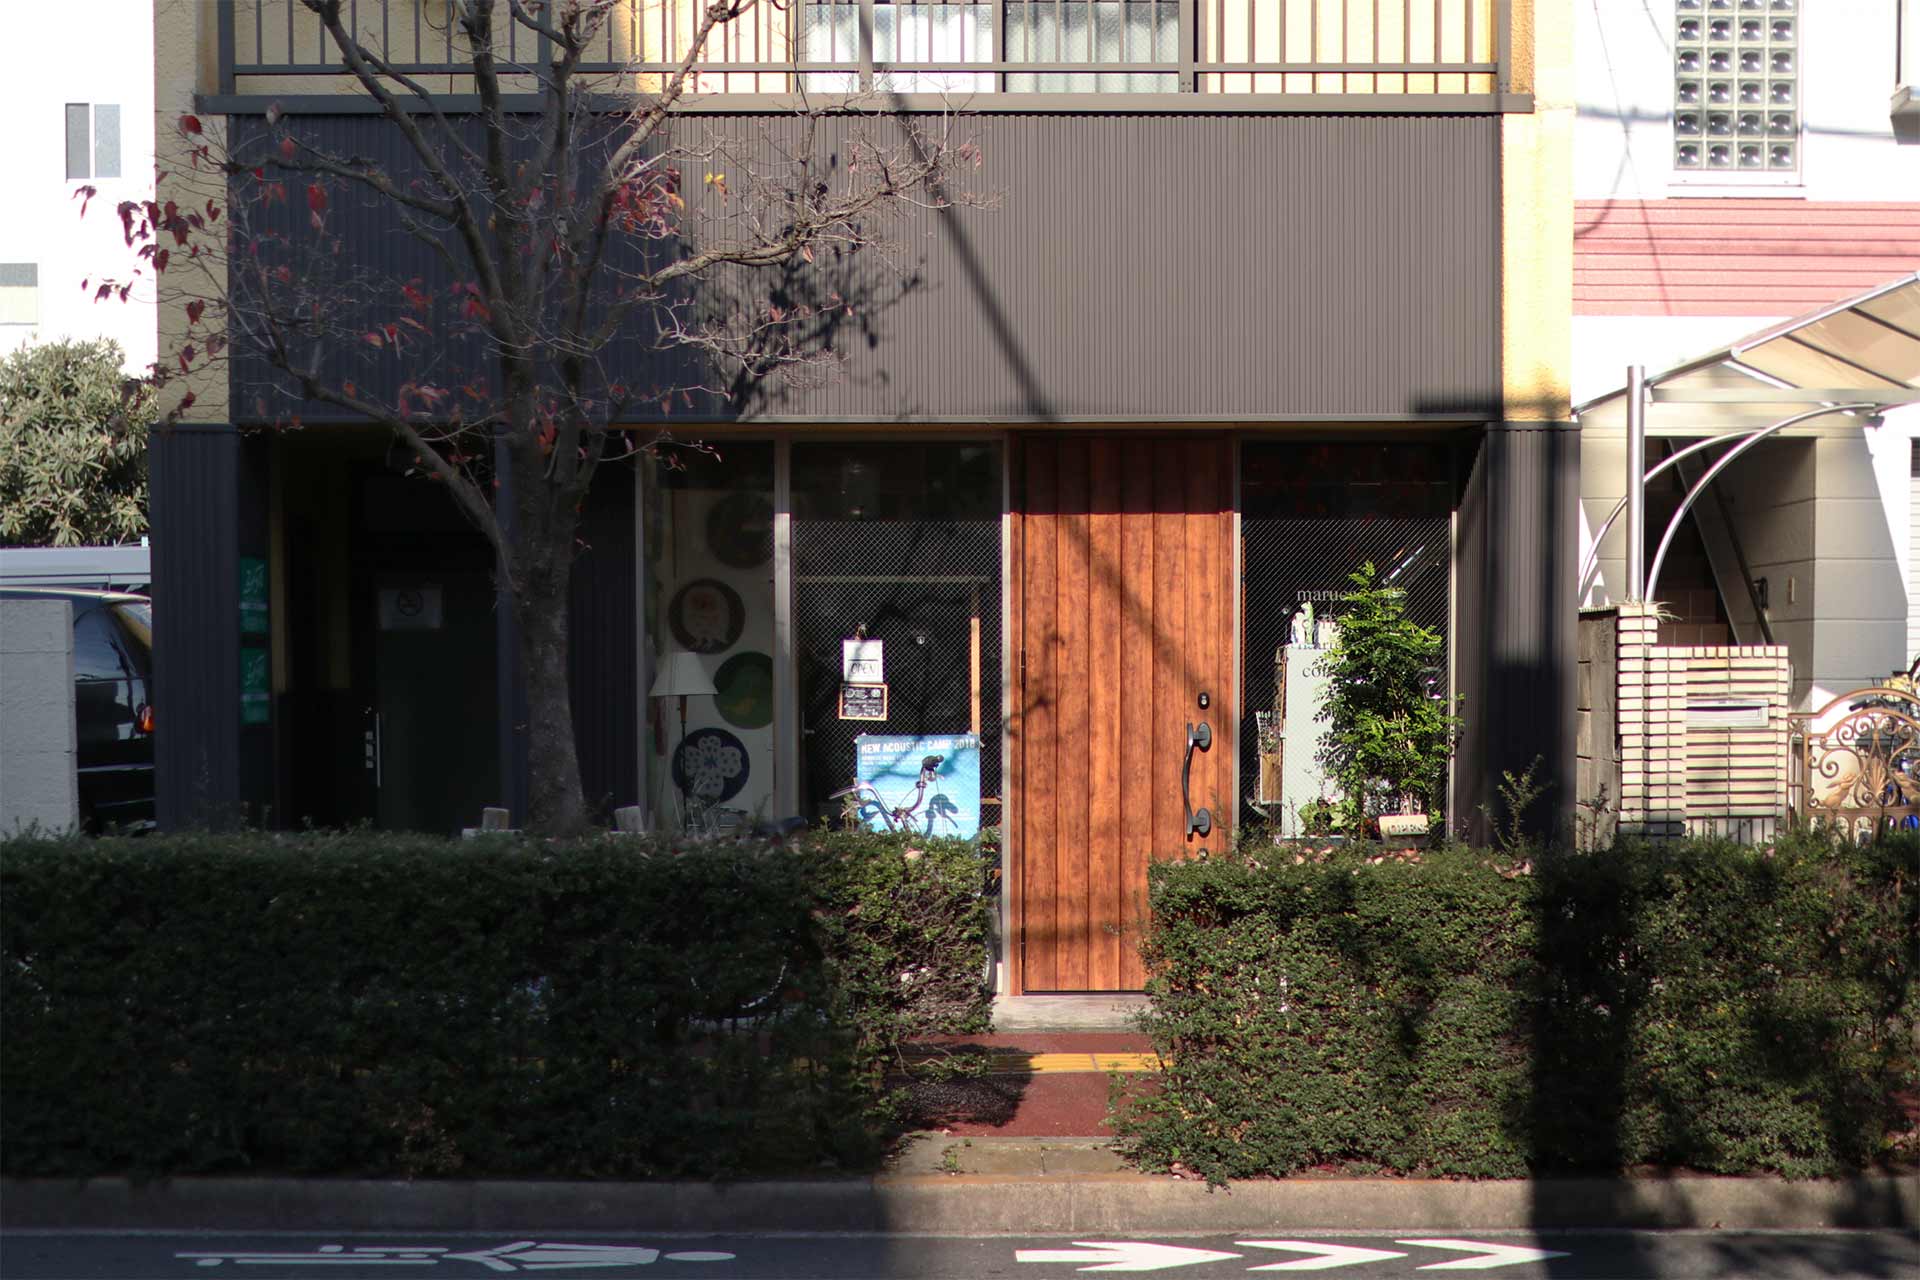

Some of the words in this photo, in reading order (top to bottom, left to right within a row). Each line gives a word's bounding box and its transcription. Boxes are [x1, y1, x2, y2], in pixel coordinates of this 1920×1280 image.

[861, 743, 880, 754] NEW
[883, 741, 925, 752] ACOUSTIC
[927, 739, 951, 750] CAMP
